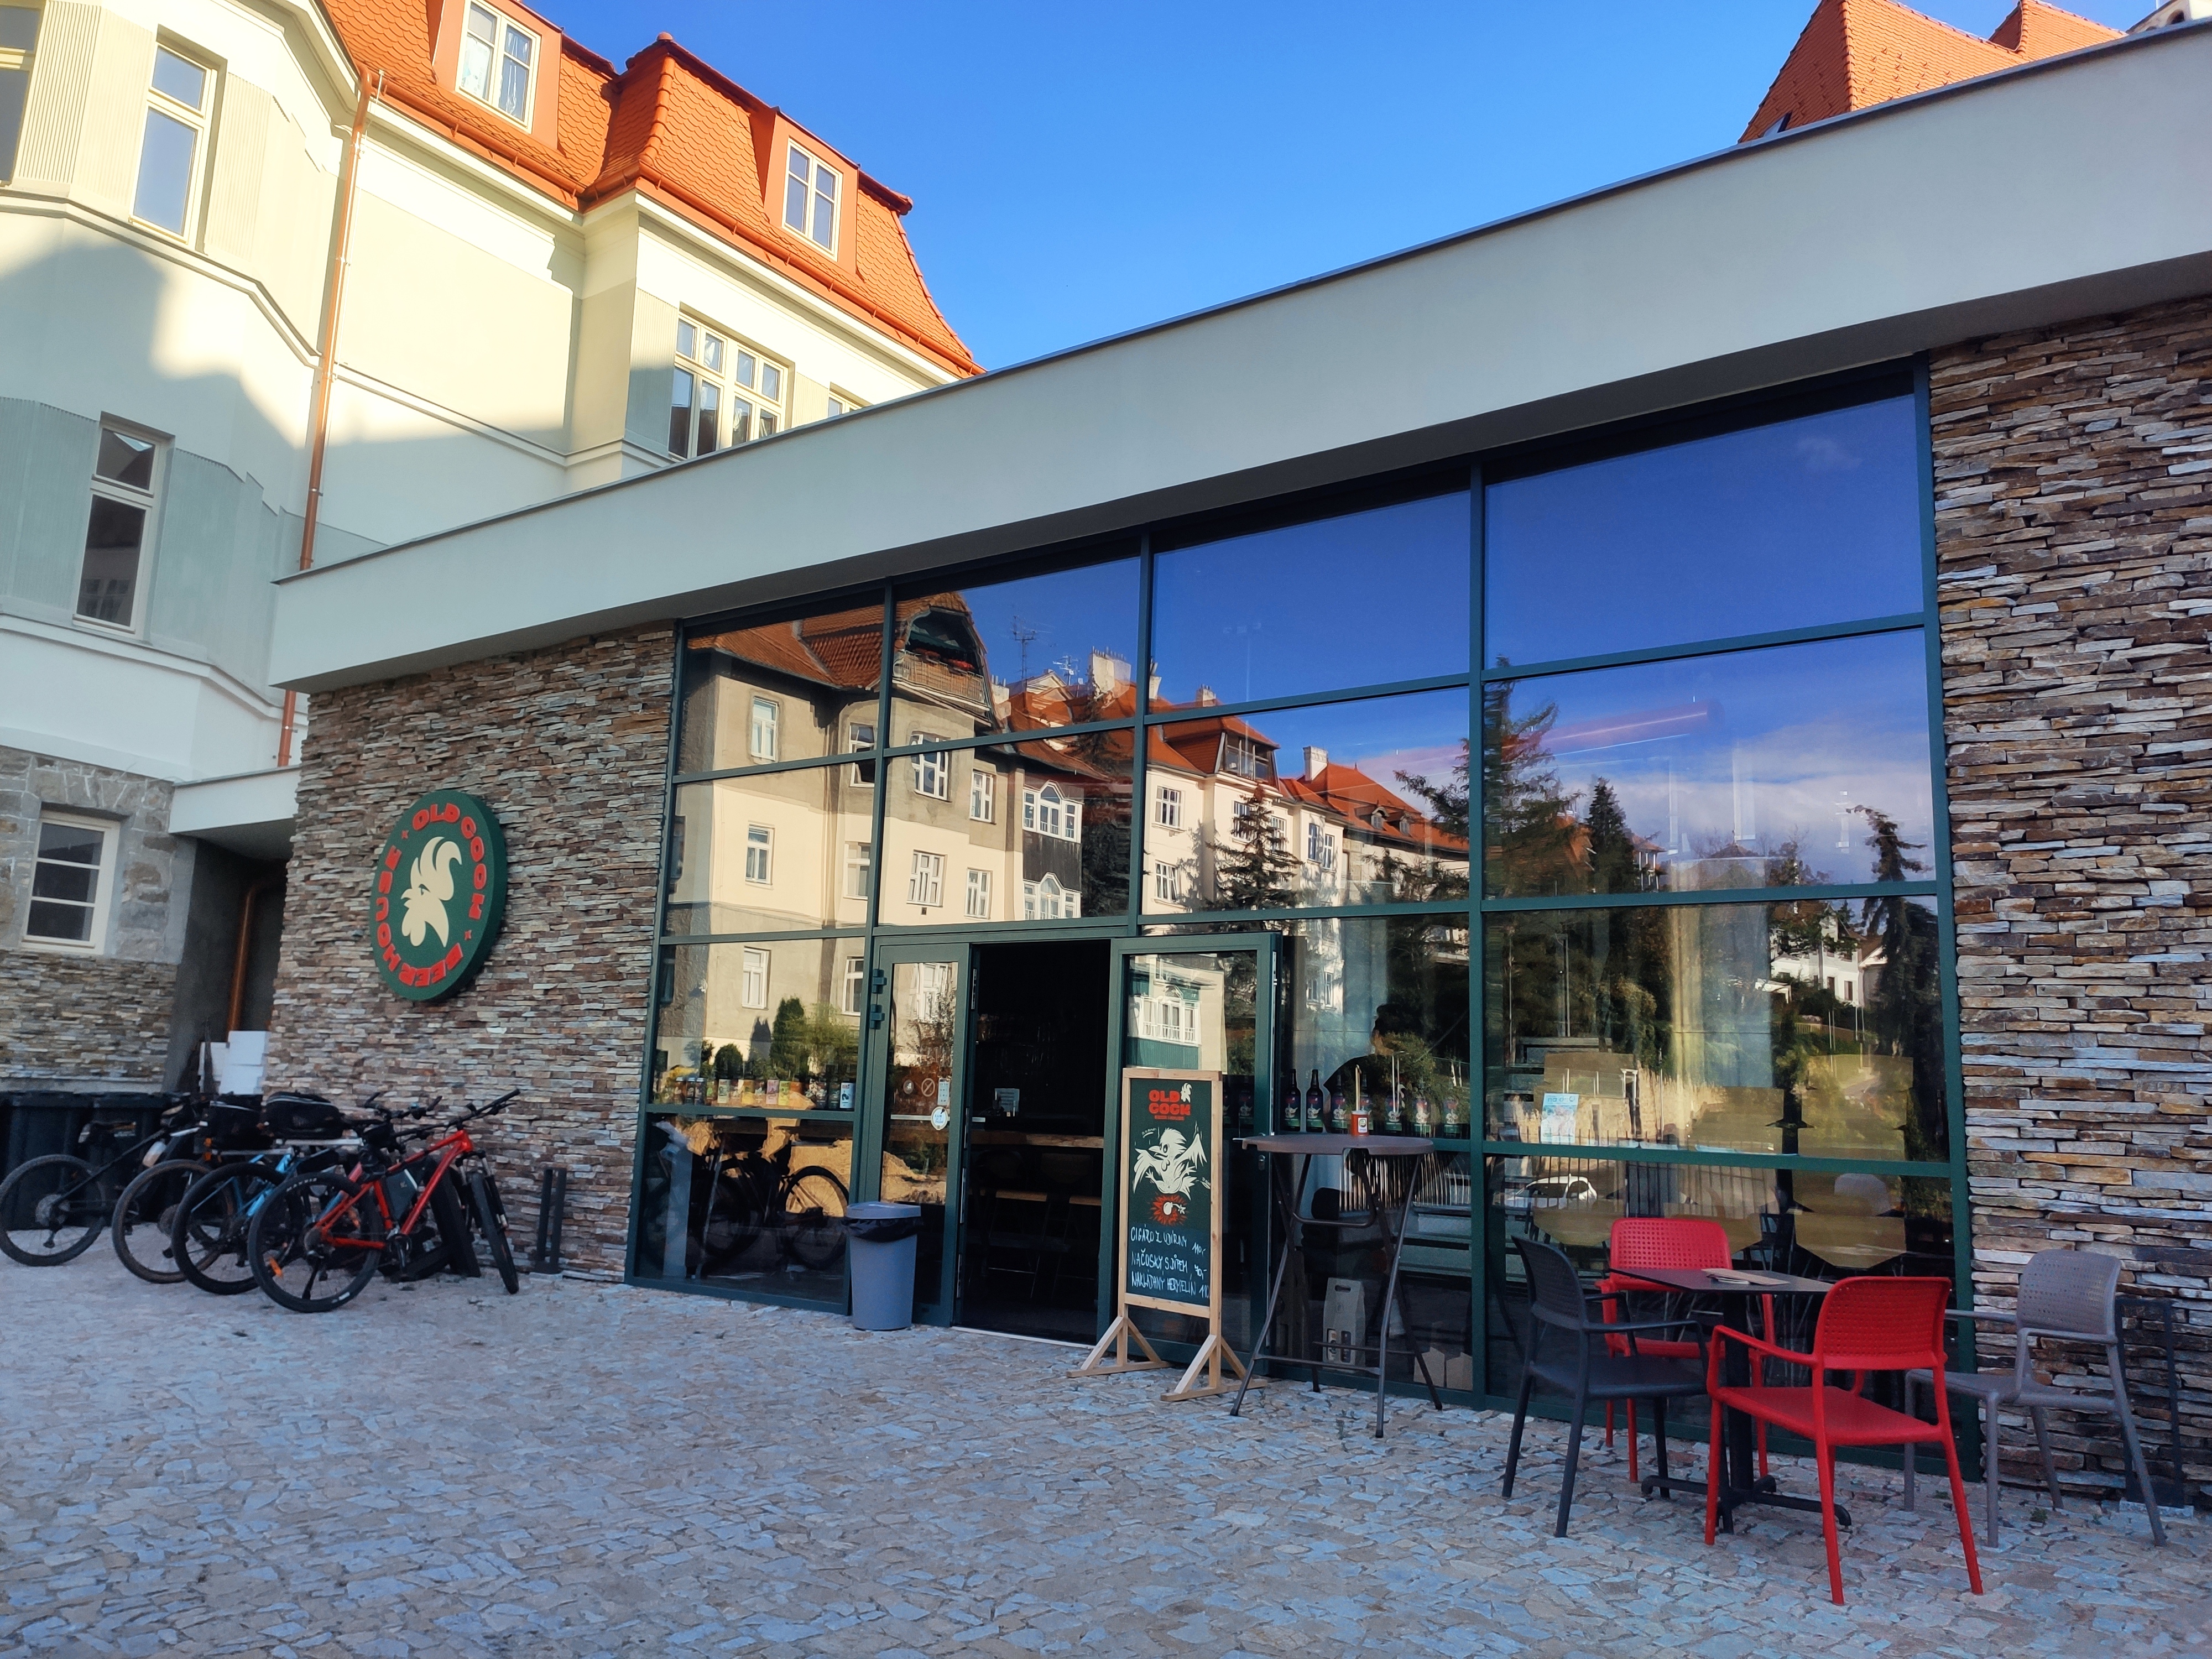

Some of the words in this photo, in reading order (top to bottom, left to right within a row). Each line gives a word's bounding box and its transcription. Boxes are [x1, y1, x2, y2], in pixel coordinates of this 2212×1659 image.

[412, 803, 460, 831] OLD
[461, 816, 487, 920] COCK
[1149, 1089, 1180, 1102] OLD
[1149, 1103, 1191, 1115] COCK
[1130, 1223, 1154, 1243] CIGÁRO
[1155, 1230, 1162, 1243] Z
[1164, 1230, 1187, 1247] UDÍRNY
[1131, 1248, 1163, 1269] NAČOSKY
[1165, 1256, 1170, 1270] S
[1131, 1269, 1165, 1291] NAKLÁDANÝ
[1167, 1273, 1196, 1296] HERMELÍN
